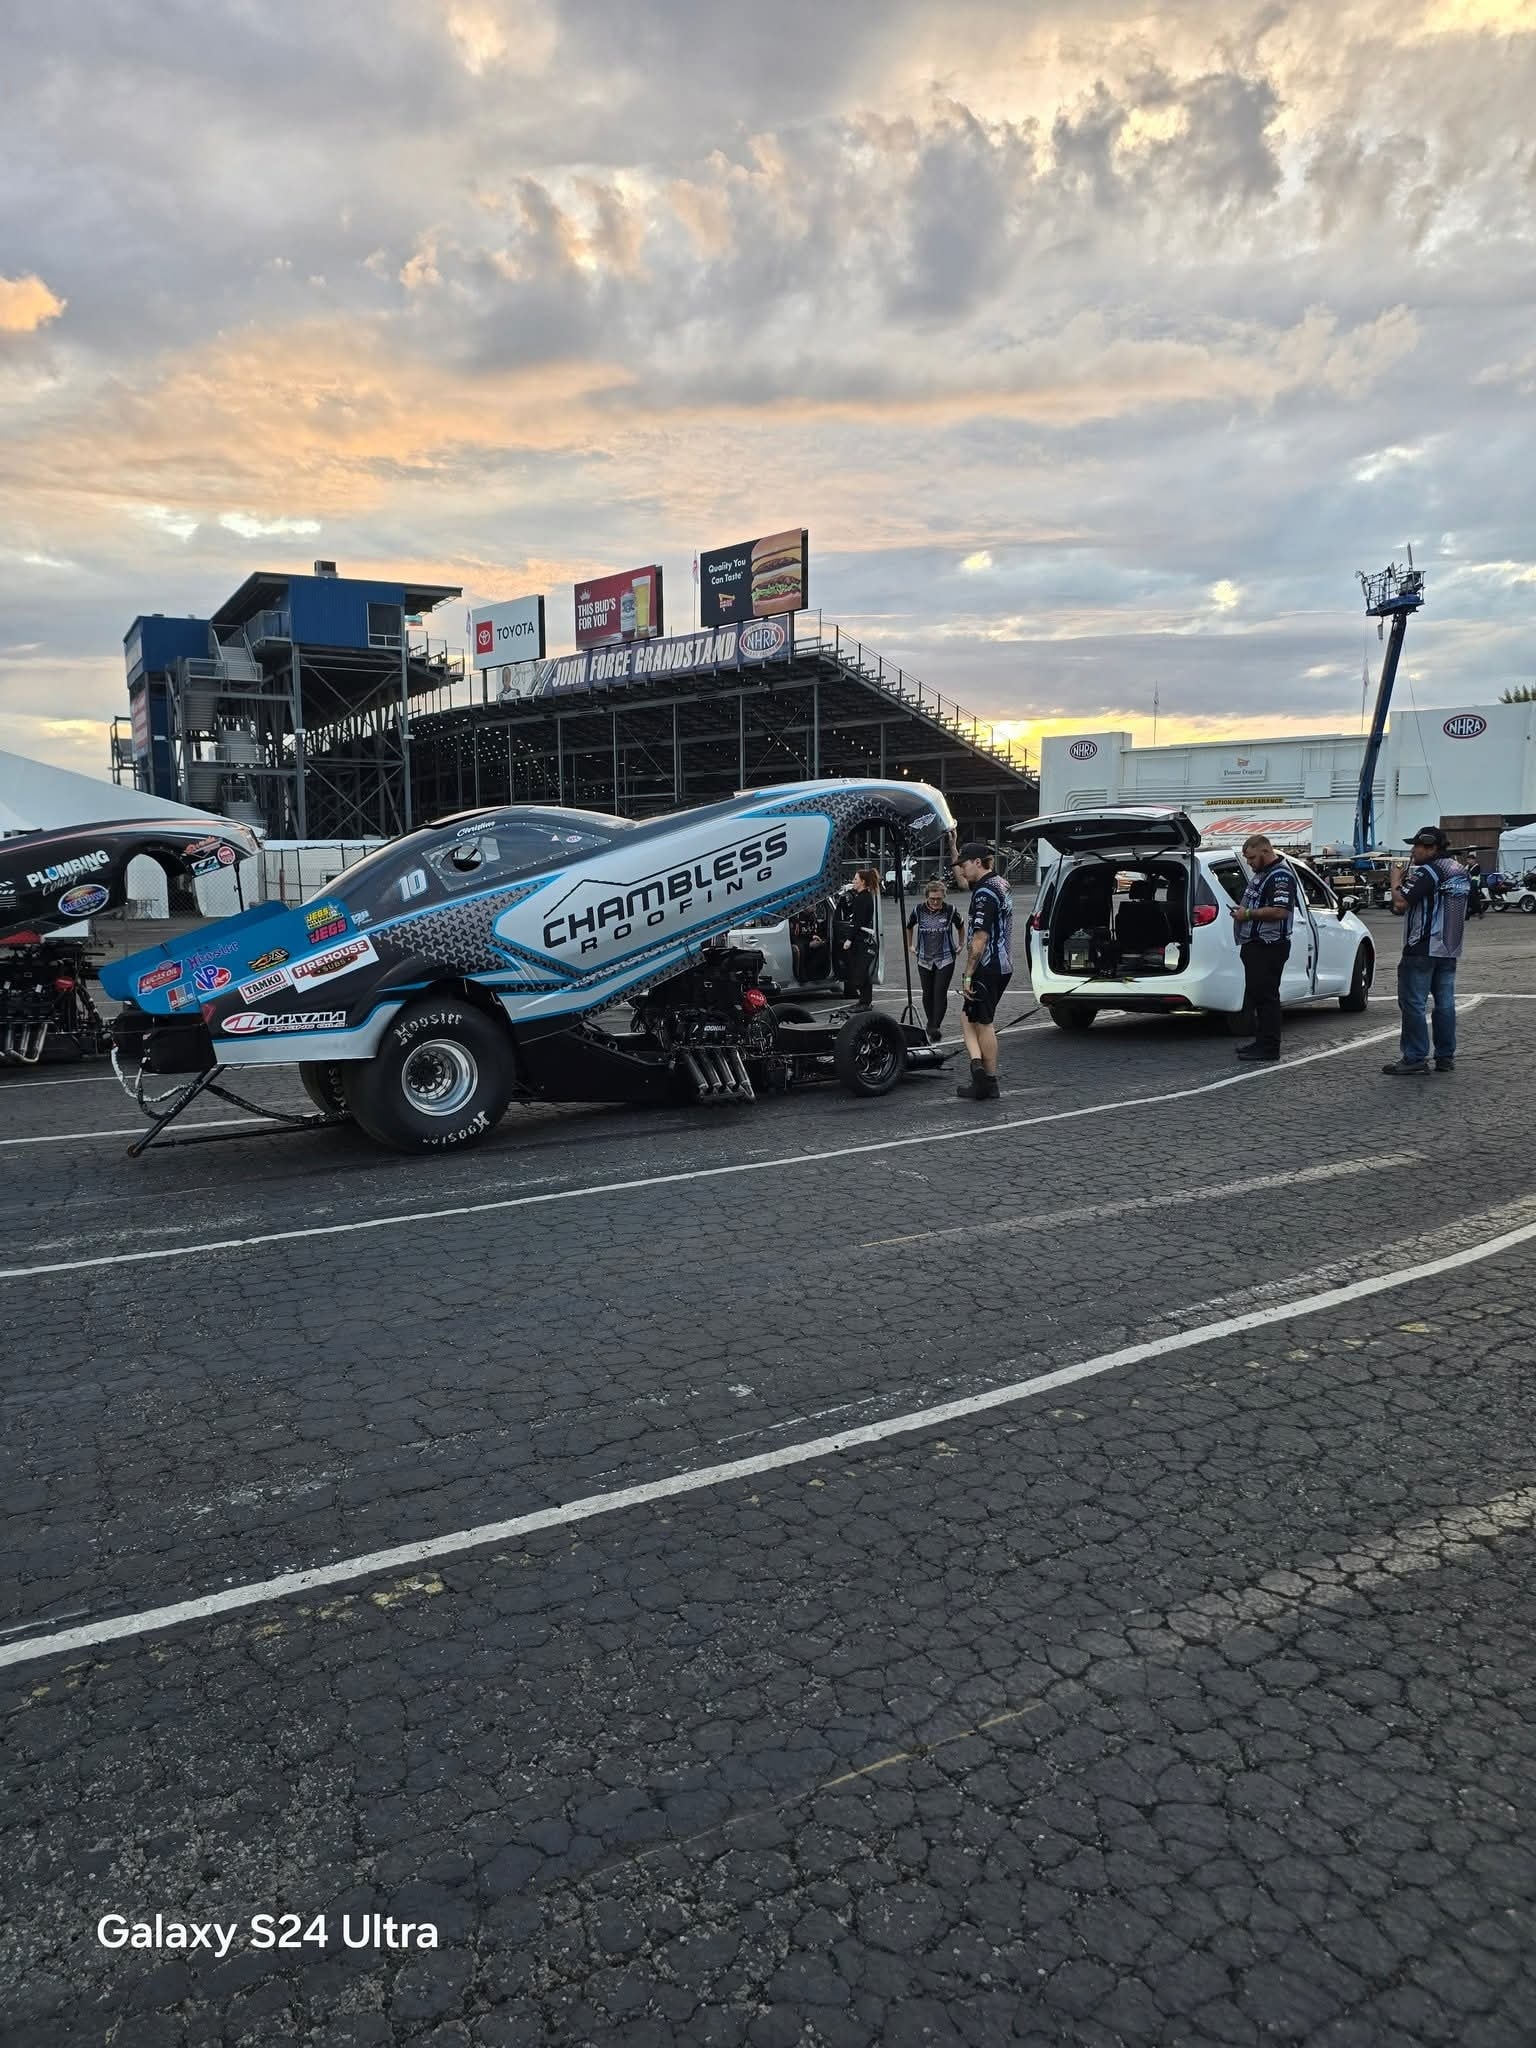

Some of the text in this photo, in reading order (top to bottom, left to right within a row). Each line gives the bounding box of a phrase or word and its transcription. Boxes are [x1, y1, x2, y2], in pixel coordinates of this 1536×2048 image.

[708, 558, 746, 573] Quality You
[711, 576, 724, 585] Can
[577, 598, 616, 617] THIS BUD'S
[496, 621, 535, 641] TOYOTA
[578, 613, 608, 631] FOR YOU
[746, 629, 777, 650] NHRA
[552, 659, 587, 688] JOHN
[588, 649, 633, 682] FORCE
[633, 631, 737, 674] GRANDSTAND
[1448, 718, 1481, 735] NHRA
[1072, 742, 1095, 758] NHRA
[26, 850, 110, 888] PLUMBING
[399, 869, 428, 900] 10
[542, 831, 788, 949] CHAMBLESS
[580, 866, 773, 954] ROOFING
[309, 919, 347, 944] JEGS
[293, 941, 369, 977] FIREHOUSE
[141, 966, 178, 988] LUCAS OIL
[193, 964, 218, 991] VP
[245, 974, 282, 995] TAMKO
[394, 1012, 463, 1046] Hoosier
